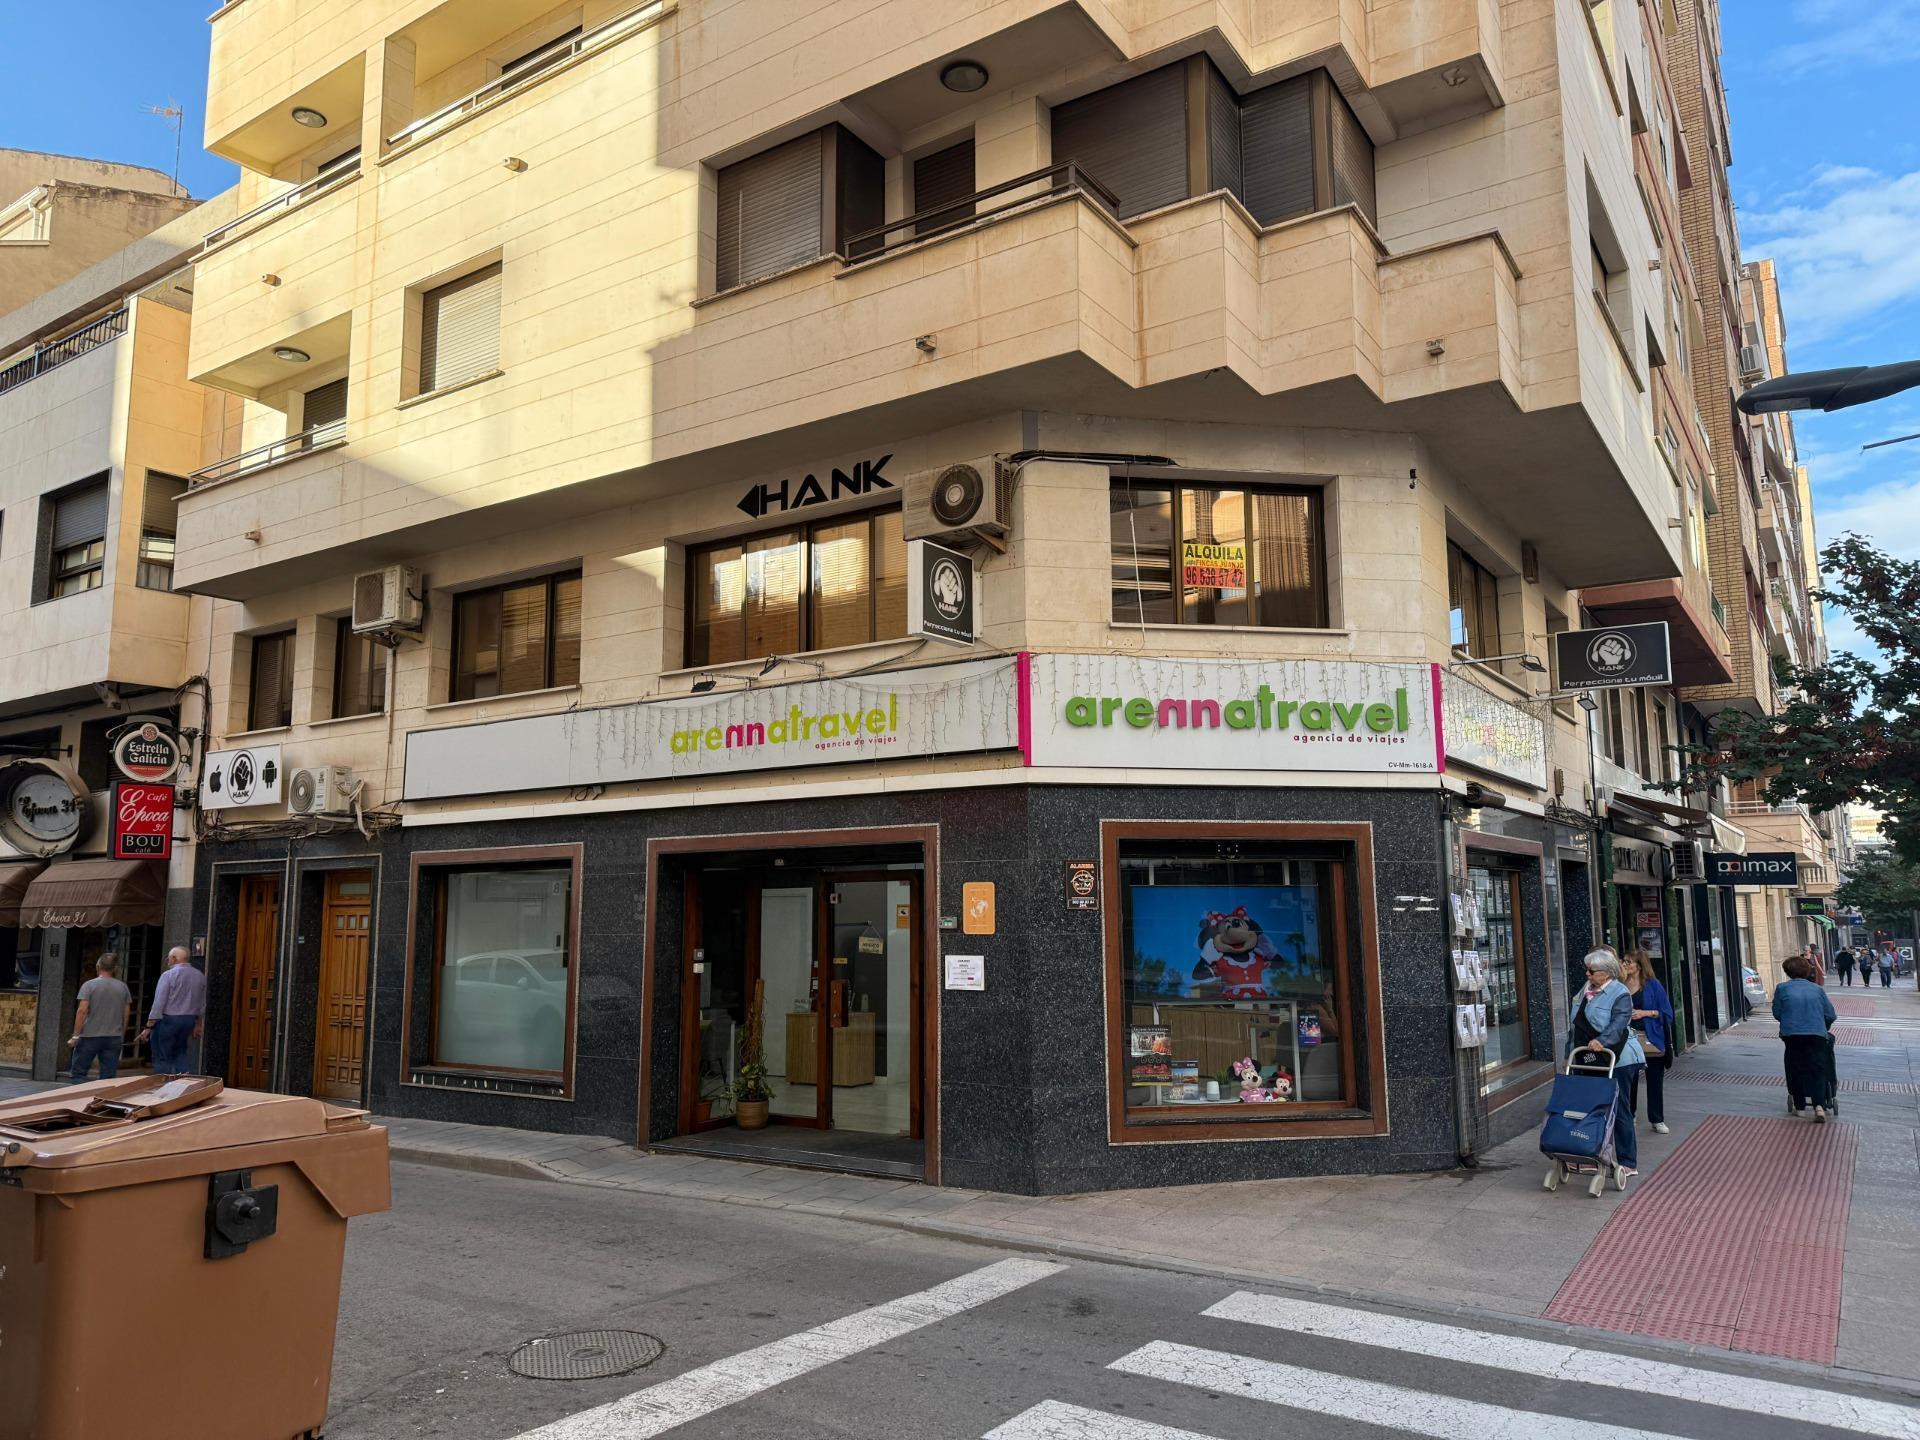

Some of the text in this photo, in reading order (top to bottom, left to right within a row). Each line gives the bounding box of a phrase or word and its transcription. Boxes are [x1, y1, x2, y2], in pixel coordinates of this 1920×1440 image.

[760, 454, 895, 516] HANK
[1185, 545, 1244, 560] ALQUILA
[1186, 566, 1197, 585] 96
[1065, 684, 1409, 733] arennatravel
[669, 692, 897, 754] arennatravel
[815, 736, 897, 750] agencia de viajes
[1293, 733, 1405, 745] agencia de viajes
[128, 742, 170, 755] Estrella
[129, 752, 168, 765] Galicia
[146, 793, 168, 803] Café
[232, 791, 250, 799] HANK
[152, 823, 166, 832] 31
[126, 835, 161, 847] BOU
[72, 911, 87, 923] 31
